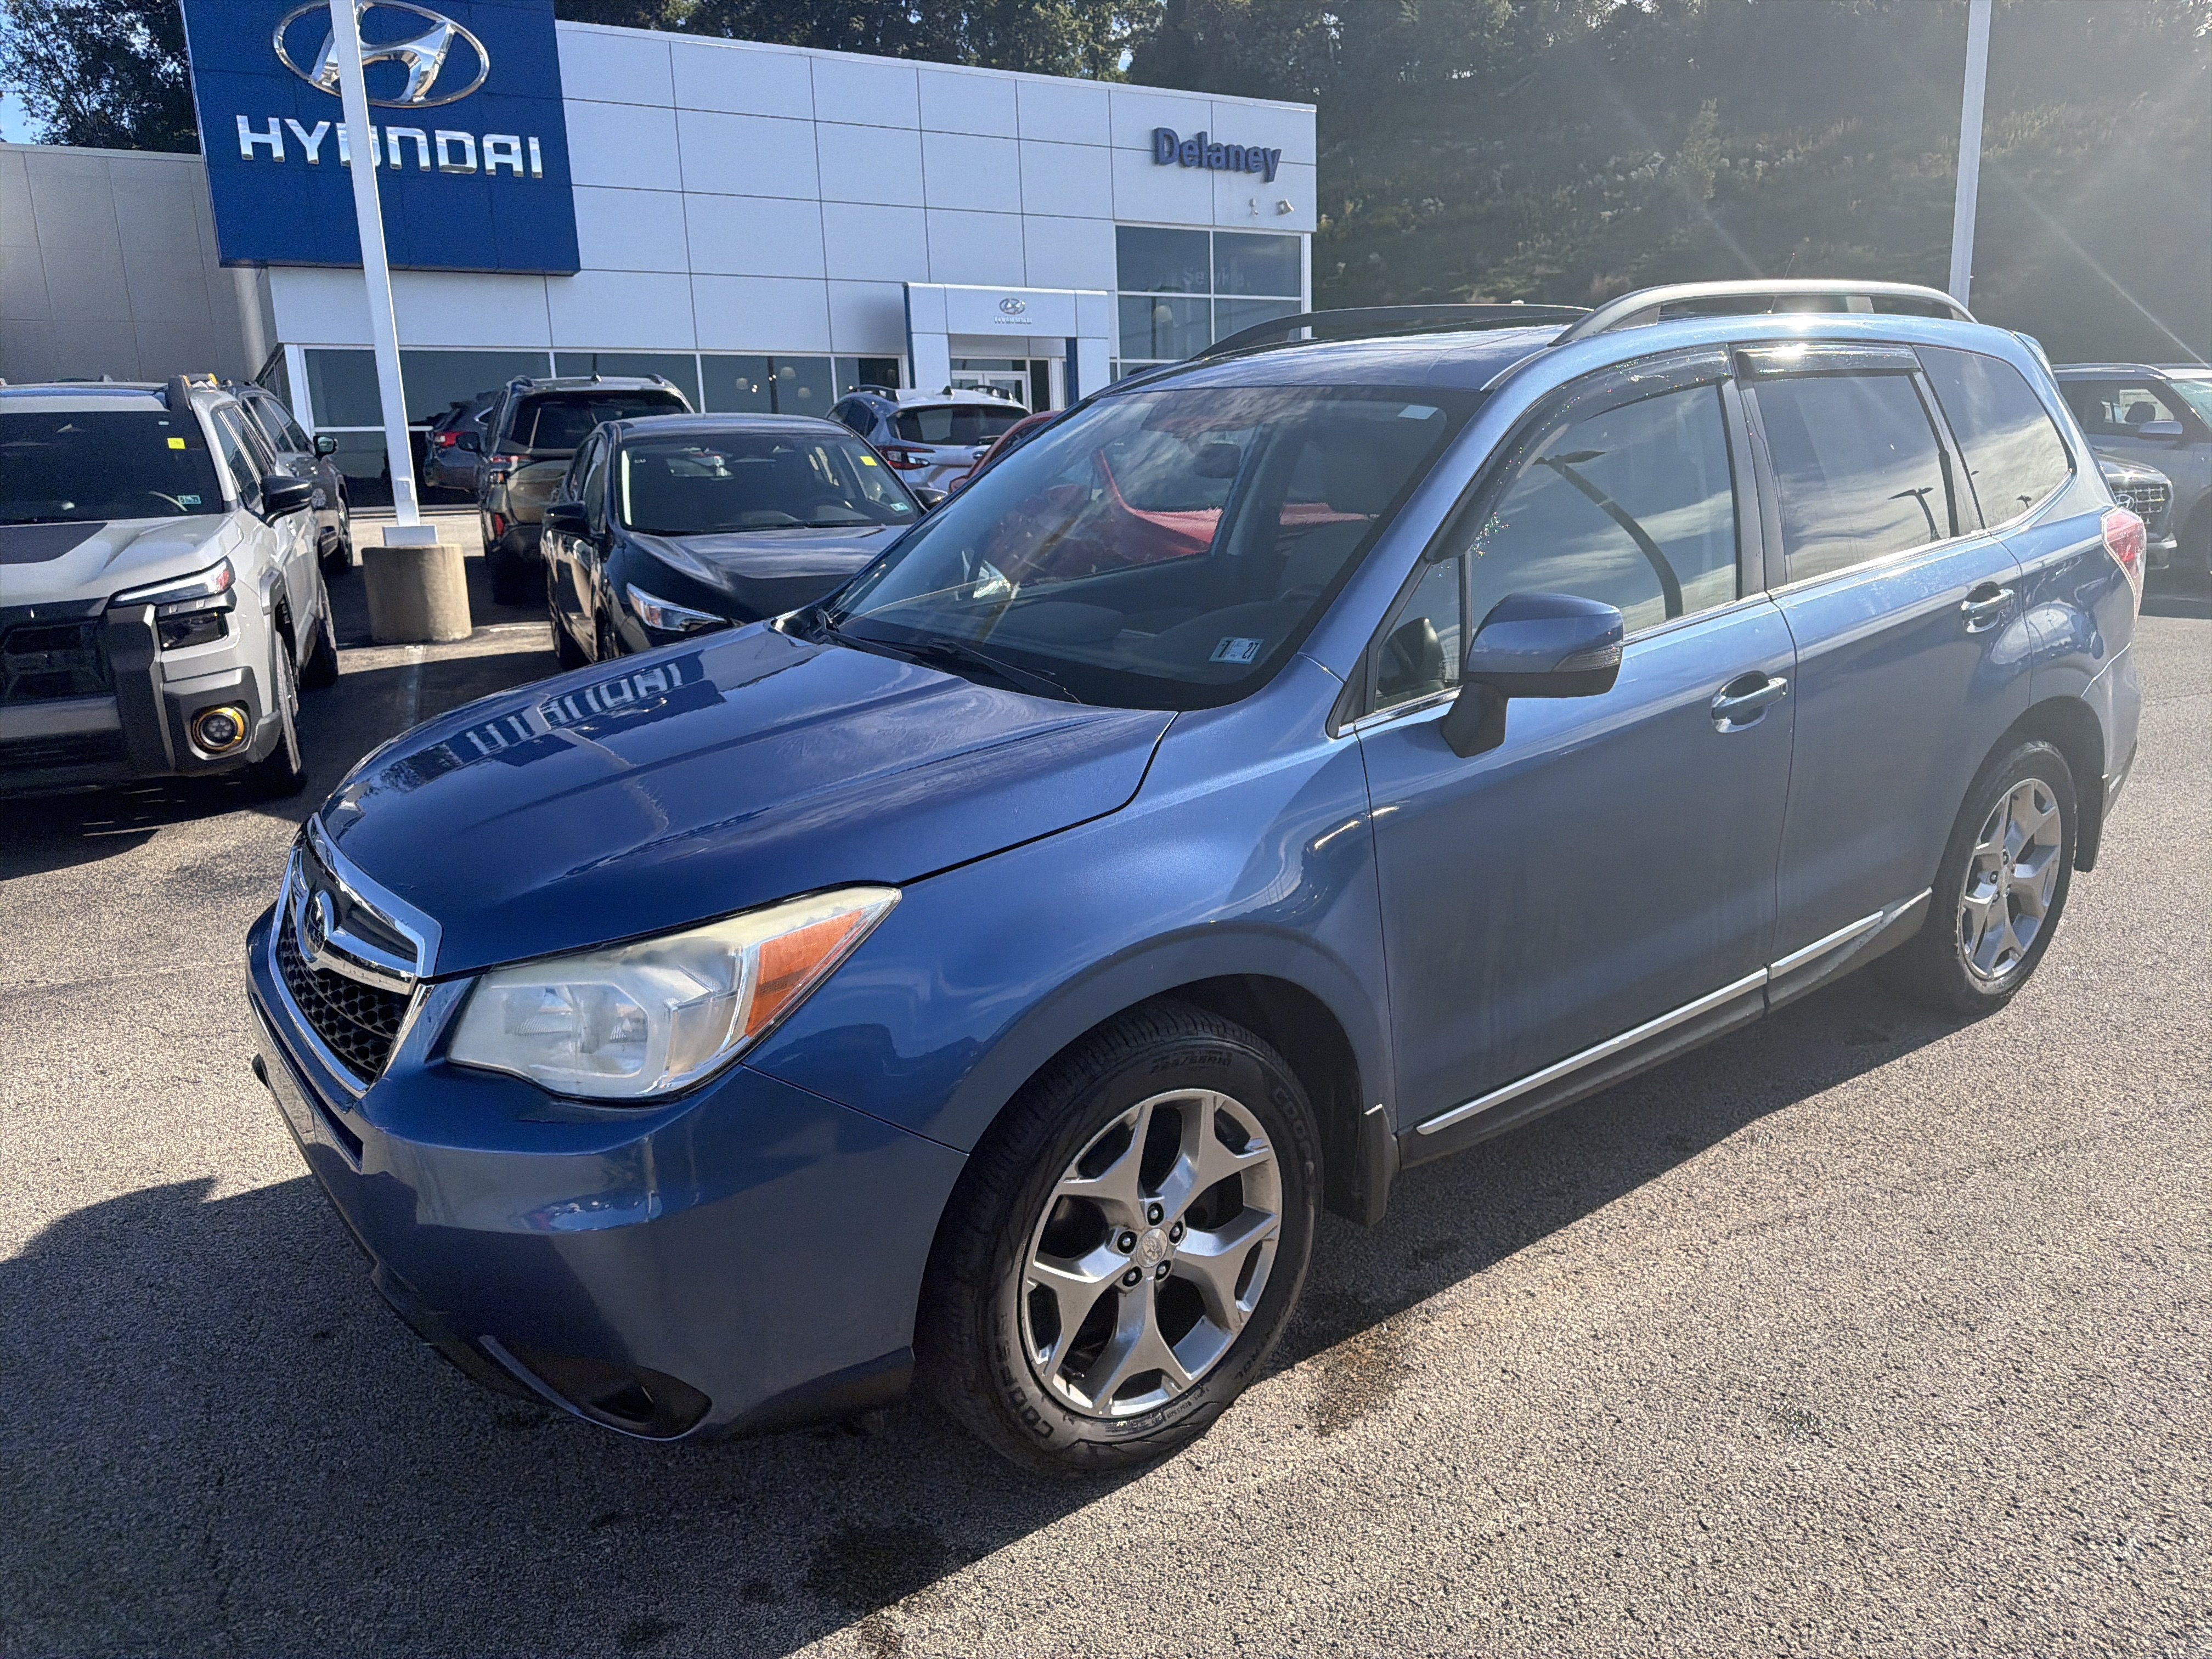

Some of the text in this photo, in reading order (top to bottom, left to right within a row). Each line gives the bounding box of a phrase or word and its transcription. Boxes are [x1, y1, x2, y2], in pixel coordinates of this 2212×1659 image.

[236, 115, 543, 178] HYUNDAI
[1153, 127, 1282, 183] Delaney
[1218, 640, 1260, 660] 7 27
